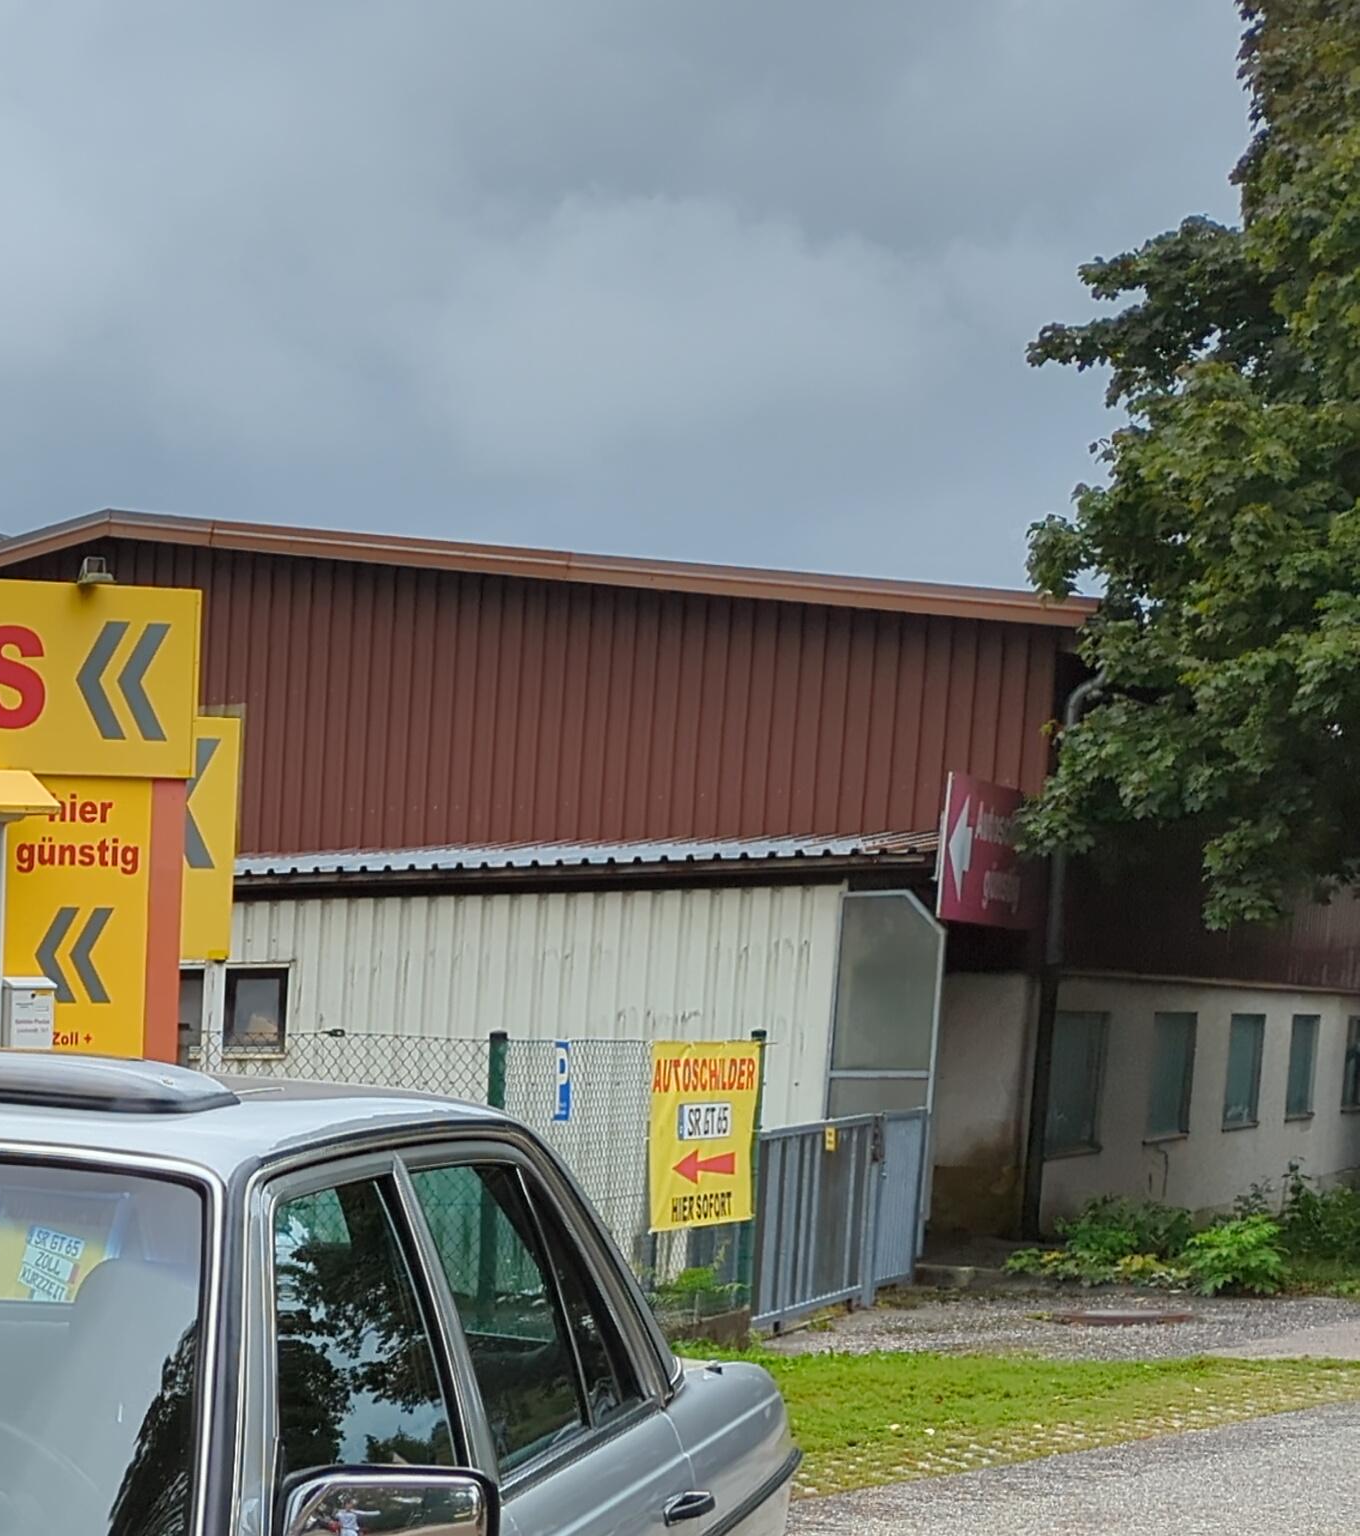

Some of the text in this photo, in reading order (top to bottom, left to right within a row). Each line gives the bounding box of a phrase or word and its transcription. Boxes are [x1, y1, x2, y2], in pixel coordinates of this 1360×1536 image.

[15, 836, 140, 876] günstig
[52, 1031, 79, 1046] Zoll
[652, 1056, 757, 1094] AUTOSCHILDER
[687, 1106, 730, 1137] SR GT 65
[671, 1190, 733, 1223] HIER SOFORT
[34, 1229, 82, 1257] SR GT 65
[34, 1251, 61, 1276] ZOLL
